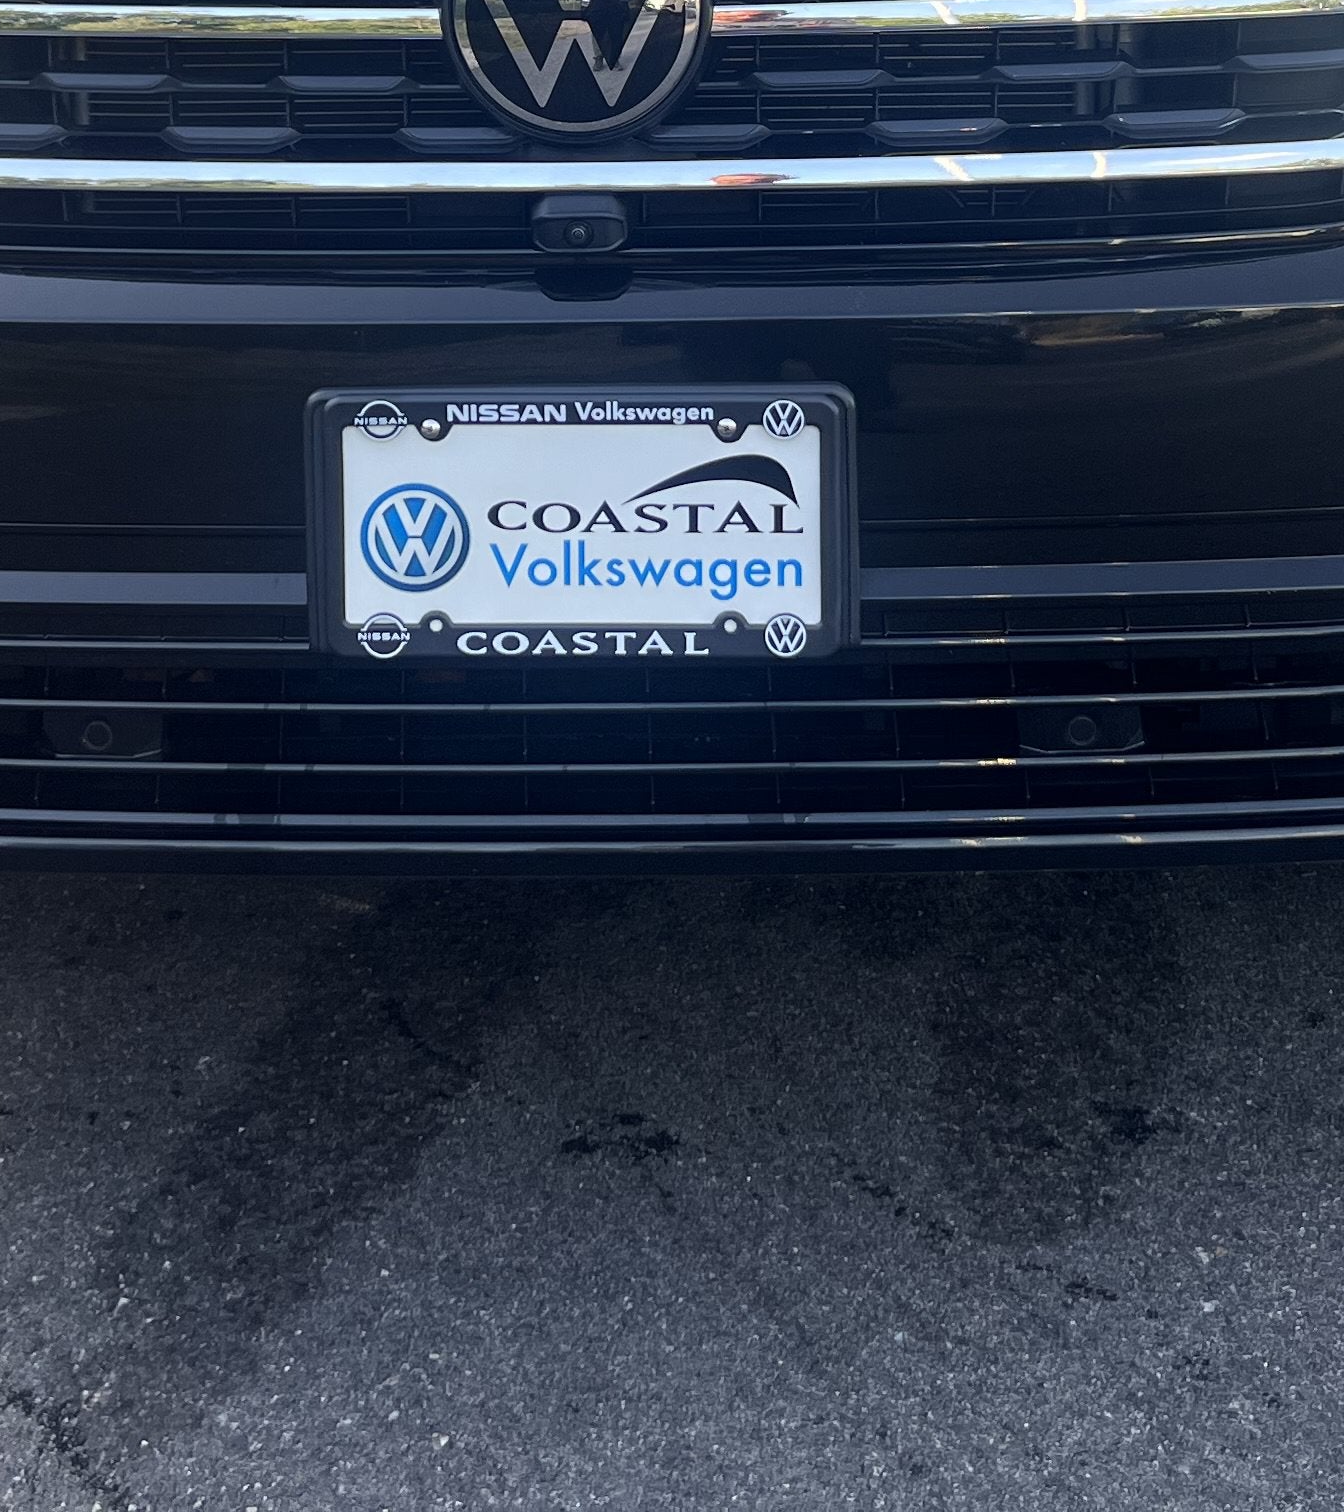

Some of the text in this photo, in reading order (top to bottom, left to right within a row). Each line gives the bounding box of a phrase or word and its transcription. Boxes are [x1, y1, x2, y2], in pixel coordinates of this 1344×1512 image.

[354, 416, 408, 426] NISSAN
[446, 400, 714, 425] NISSAN Volkswagen
[762, 399, 805, 439] VW
[487, 499, 804, 534] COASTAL
[360, 483, 470, 592] VW
[489, 539, 803, 601] Volkswagen
[357, 631, 411, 642] NISSAN
[456, 630, 710, 656] COASTAL
[764, 614, 807, 657] VW
